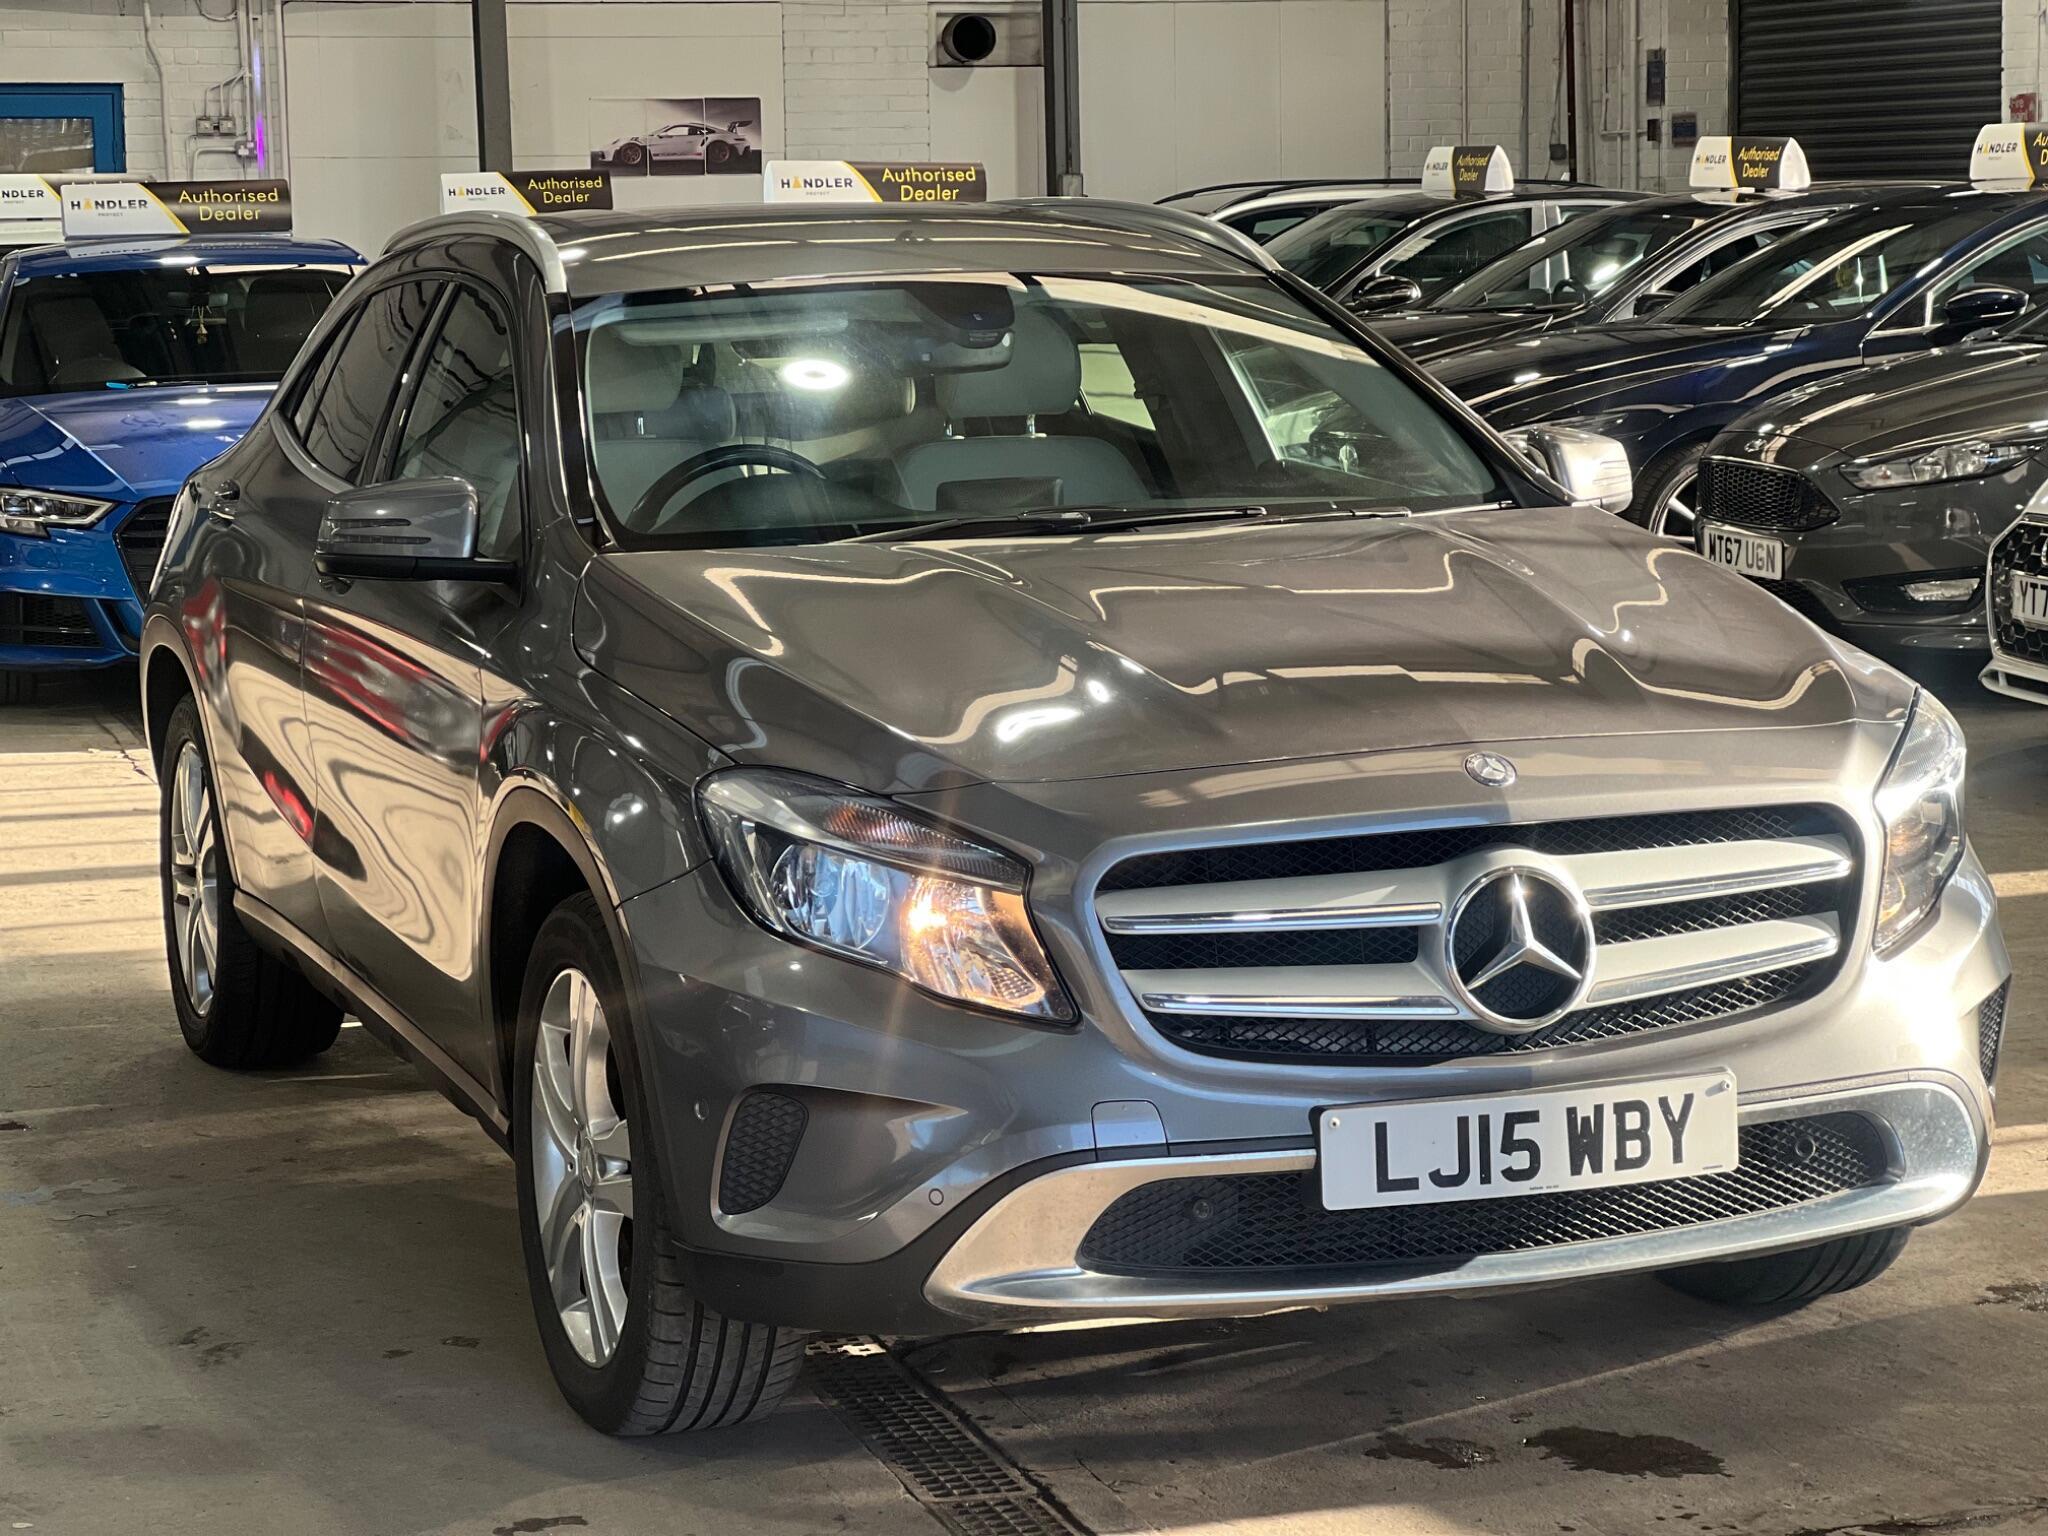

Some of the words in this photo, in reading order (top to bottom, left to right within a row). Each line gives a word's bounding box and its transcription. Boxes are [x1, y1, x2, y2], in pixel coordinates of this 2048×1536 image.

[1738, 145, 1782, 161] Authorised
[1977, 143, 2018, 154] HANDLER
[1426, 162, 1449, 171] HNDLER
[1456, 153, 1490, 167] Authorised
[882, 166, 977, 183] Authorised
[1459, 168, 1478, 182] Dealer
[1742, 162, 1769, 178] Dealer
[527, 175, 603, 190] Authorised
[780, 176, 853, 189] HANDLER
[178, 187, 279, 203] Authorised
[448, 186, 506, 197] HANDLER
[543, 190, 590, 204] Dealer
[900, 183, 960, 201] Dealer
[70, 198, 148, 211] HANDLER
[199, 204, 261, 221] Dealer
[1709, 532, 1742, 567] MT67
[1745, 540, 1776, 573] UGN
[1374, 1110, 1541, 1194] LJ15
[1566, 1093, 1695, 1177] WBY
